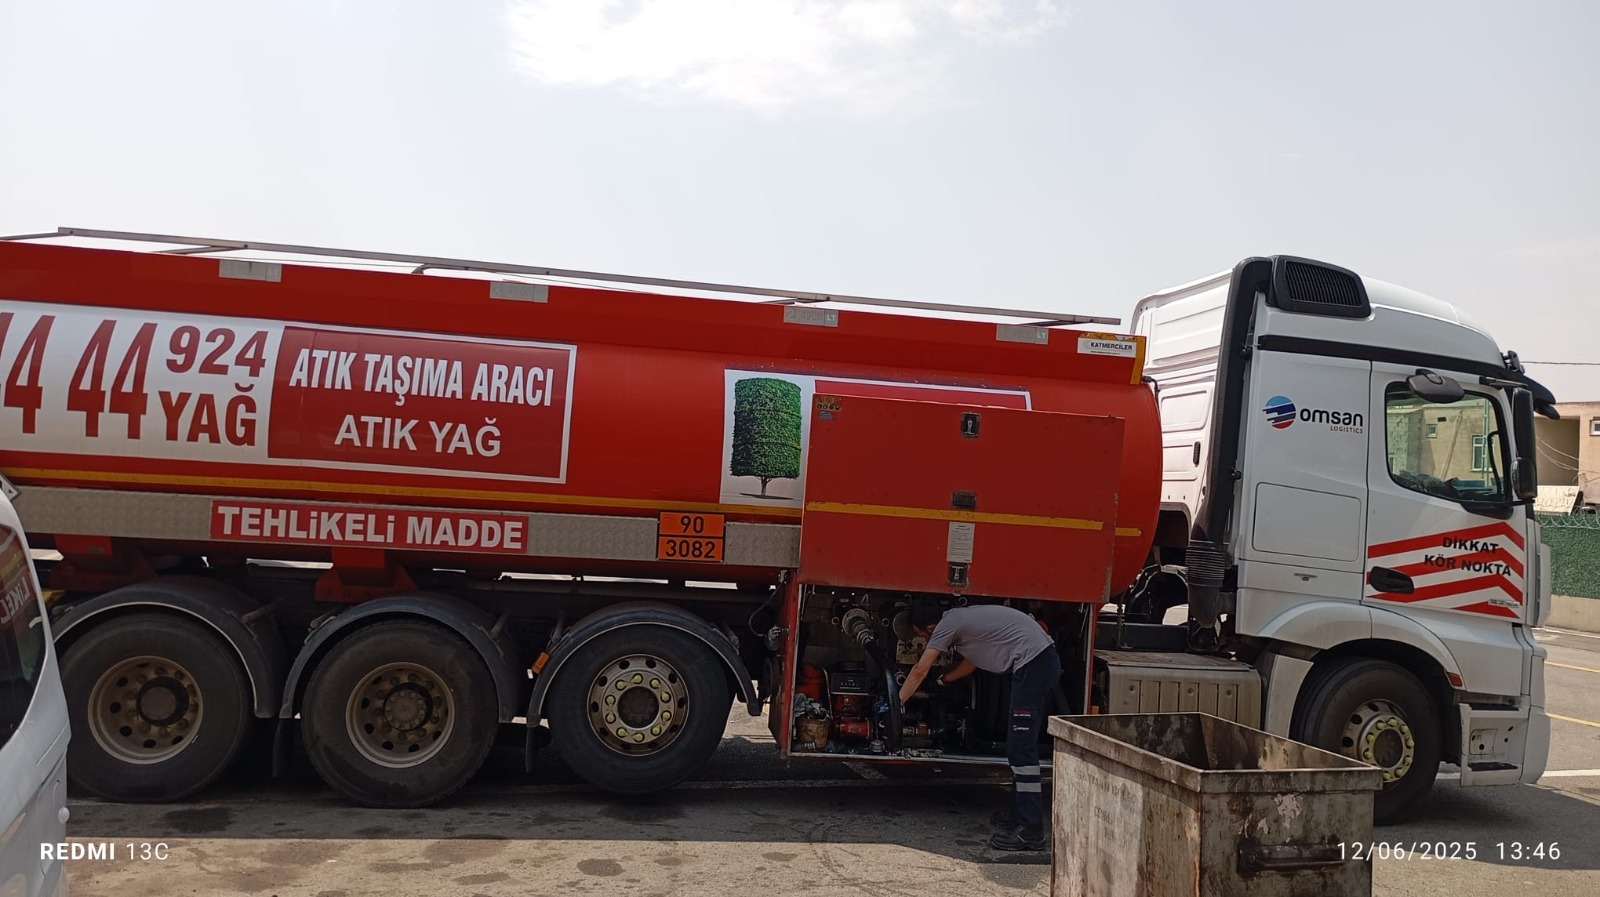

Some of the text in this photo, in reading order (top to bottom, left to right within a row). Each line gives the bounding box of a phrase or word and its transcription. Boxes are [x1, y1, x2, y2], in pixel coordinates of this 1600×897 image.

[827, 313, 837, 321] LT
[1037, 331, 1047, 339] LT
[166, 325, 268, 378] 924
[66, 319, 158, 440] 44
[288, 348, 554, 406] ATIK TAŞIMA ARACI
[158, 382, 256, 446] YAĞ
[1300, 408, 1363, 427] omsan
[334, 414, 501, 457] ATIK YAĞ
[1330, 426, 1363, 434] LOGISTICS
[406, 516, 523, 549] MADDE
[680, 515, 704, 534] 90
[665, 540, 716, 558] 3082
[1442, 535, 1499, 554] DİKKAT
[1424, 553, 1512, 576] KÖR NOKTA
